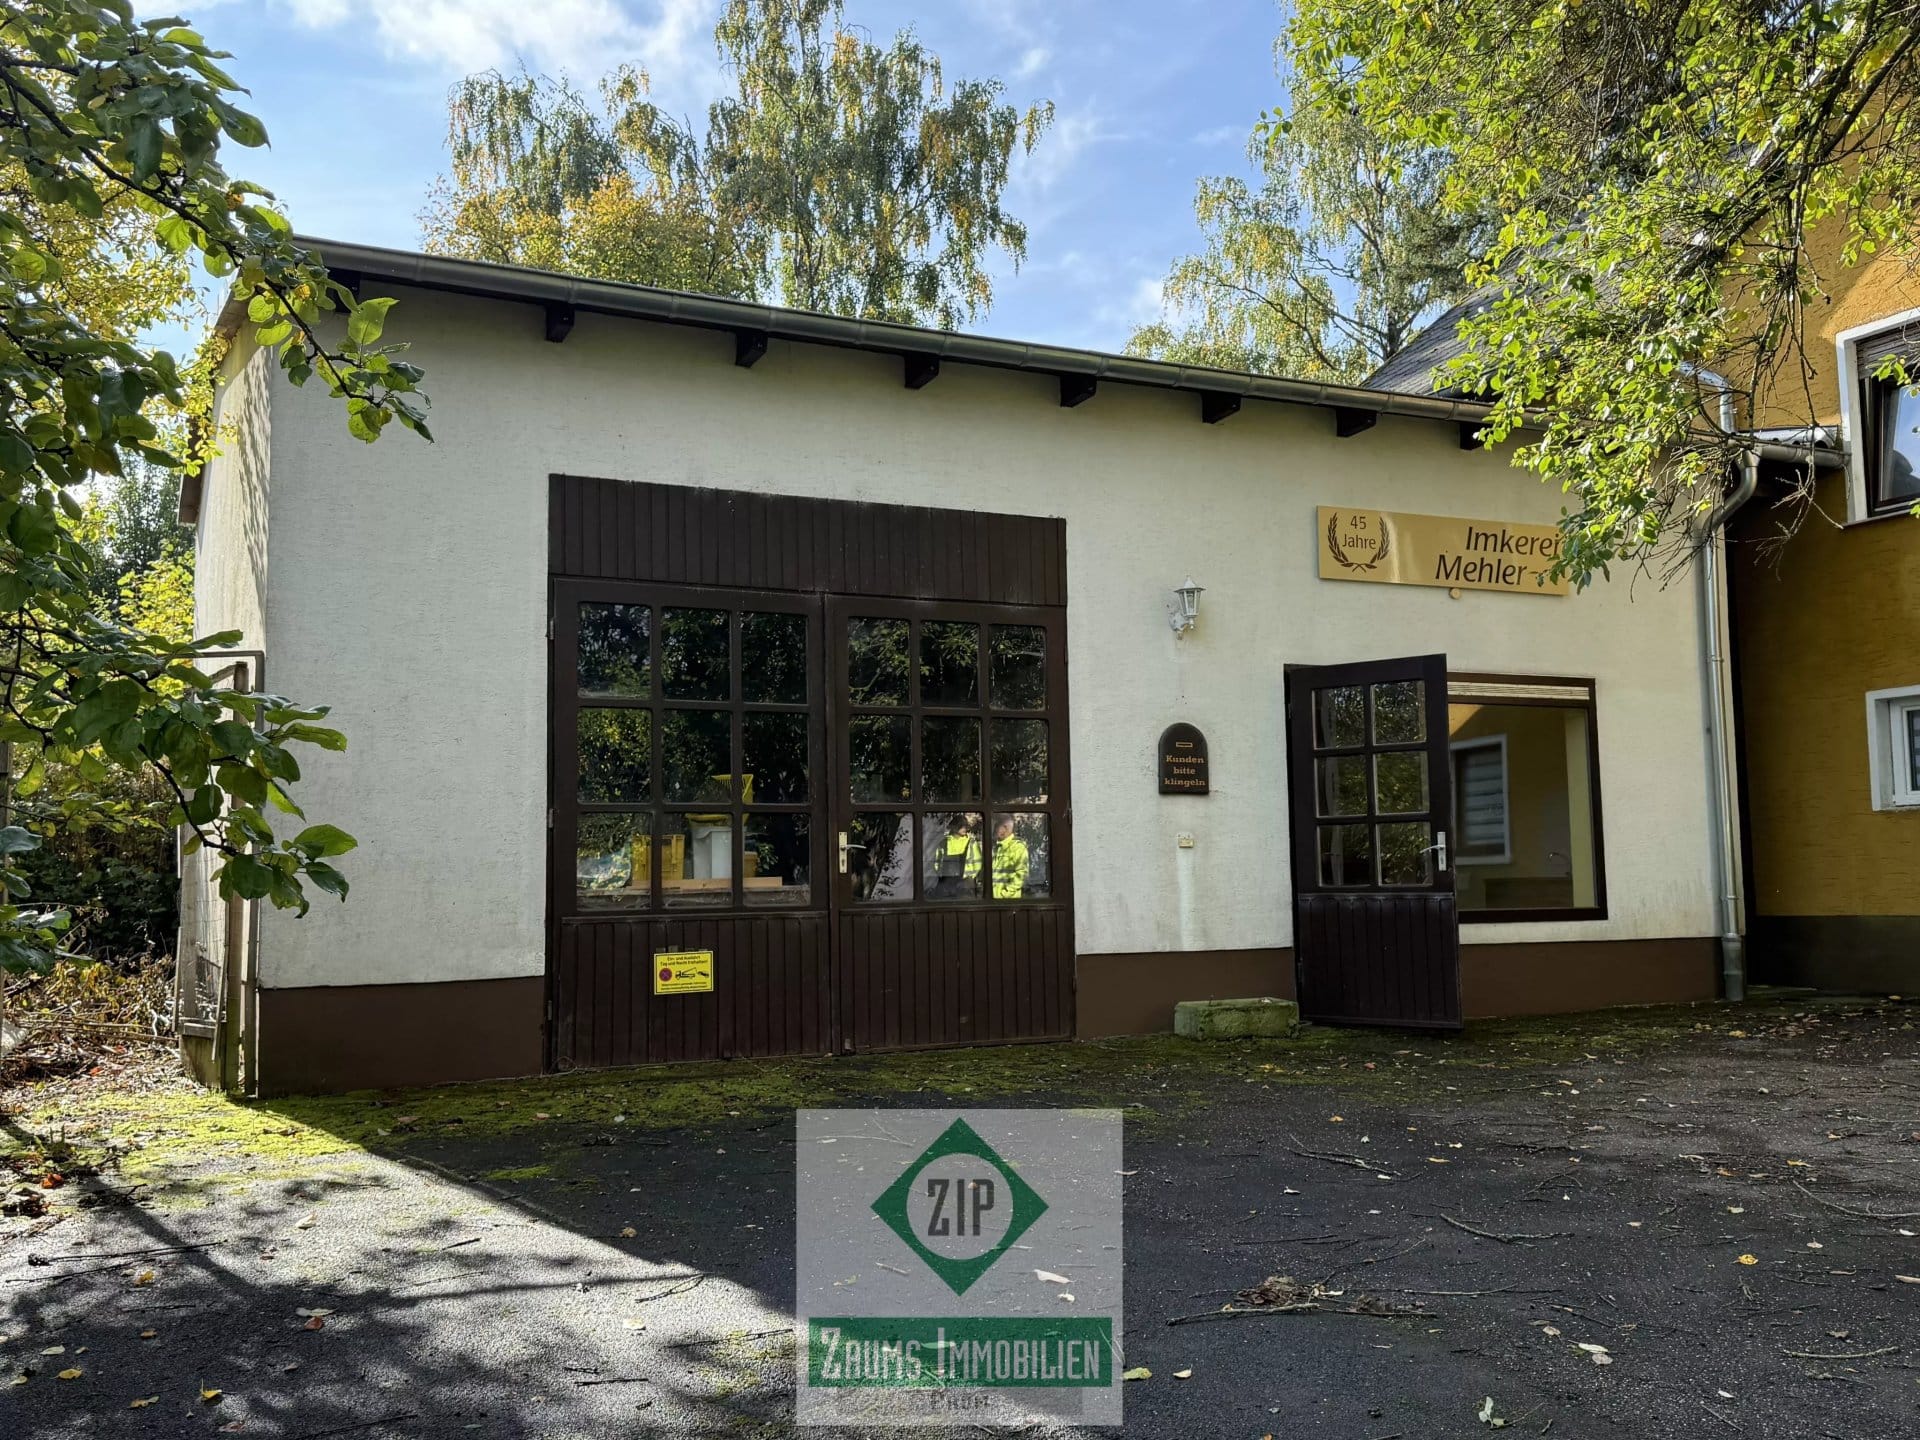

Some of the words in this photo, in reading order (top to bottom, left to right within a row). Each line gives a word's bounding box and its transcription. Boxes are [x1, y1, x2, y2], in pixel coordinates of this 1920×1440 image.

[1350, 515, 1367, 530] 45
[1342, 533, 1377, 550] Jahre
[1465, 526, 1559, 558] Imkerei
[1435, 554, 1528, 586] Mehler
[1166, 755, 1204, 764] Kunden
[1173, 766, 1196, 775] bitte
[1164, 778, 1206, 787] klingeln
